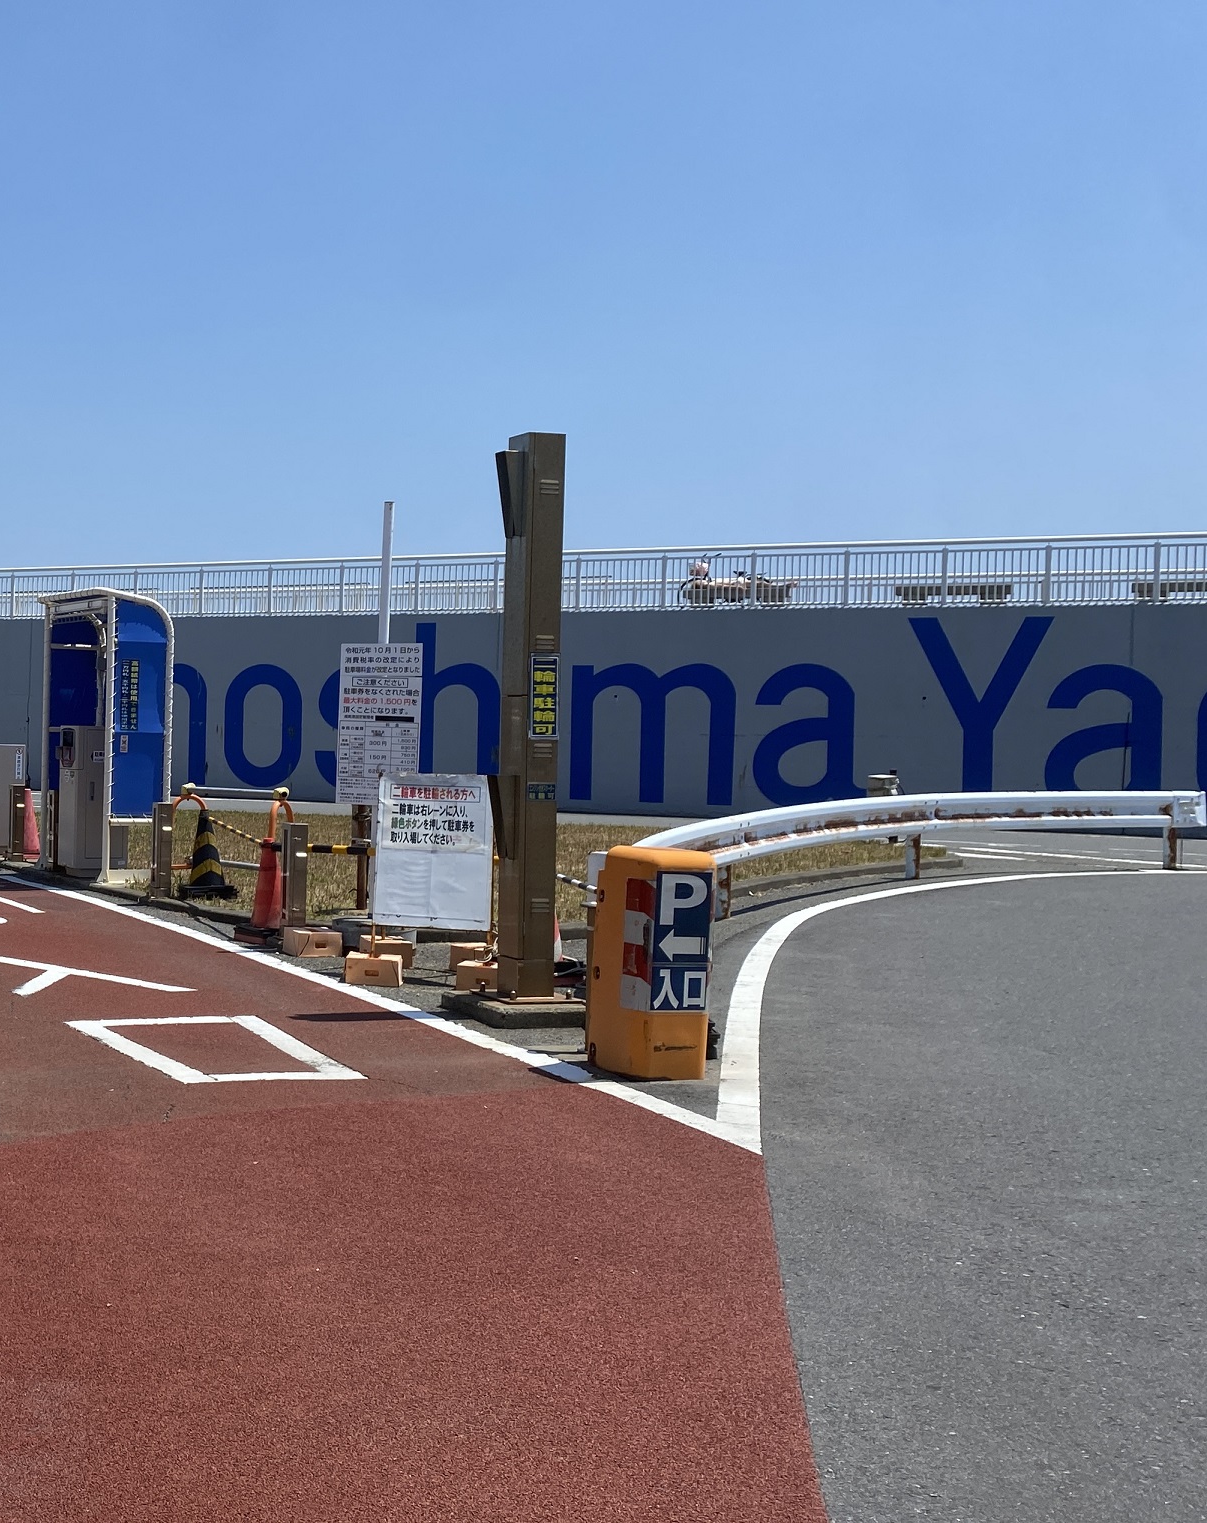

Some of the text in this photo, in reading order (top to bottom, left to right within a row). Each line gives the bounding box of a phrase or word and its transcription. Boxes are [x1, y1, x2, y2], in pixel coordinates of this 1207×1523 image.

[533, 658, 556, 736] 二輪車駐輪可
[908, 615, 1207, 792] Ya
[392, 786, 476, 800] 二輪車を駐輪される方へ
[659, 873, 708, 926] P
[653, 968, 707, 1009] 入口
